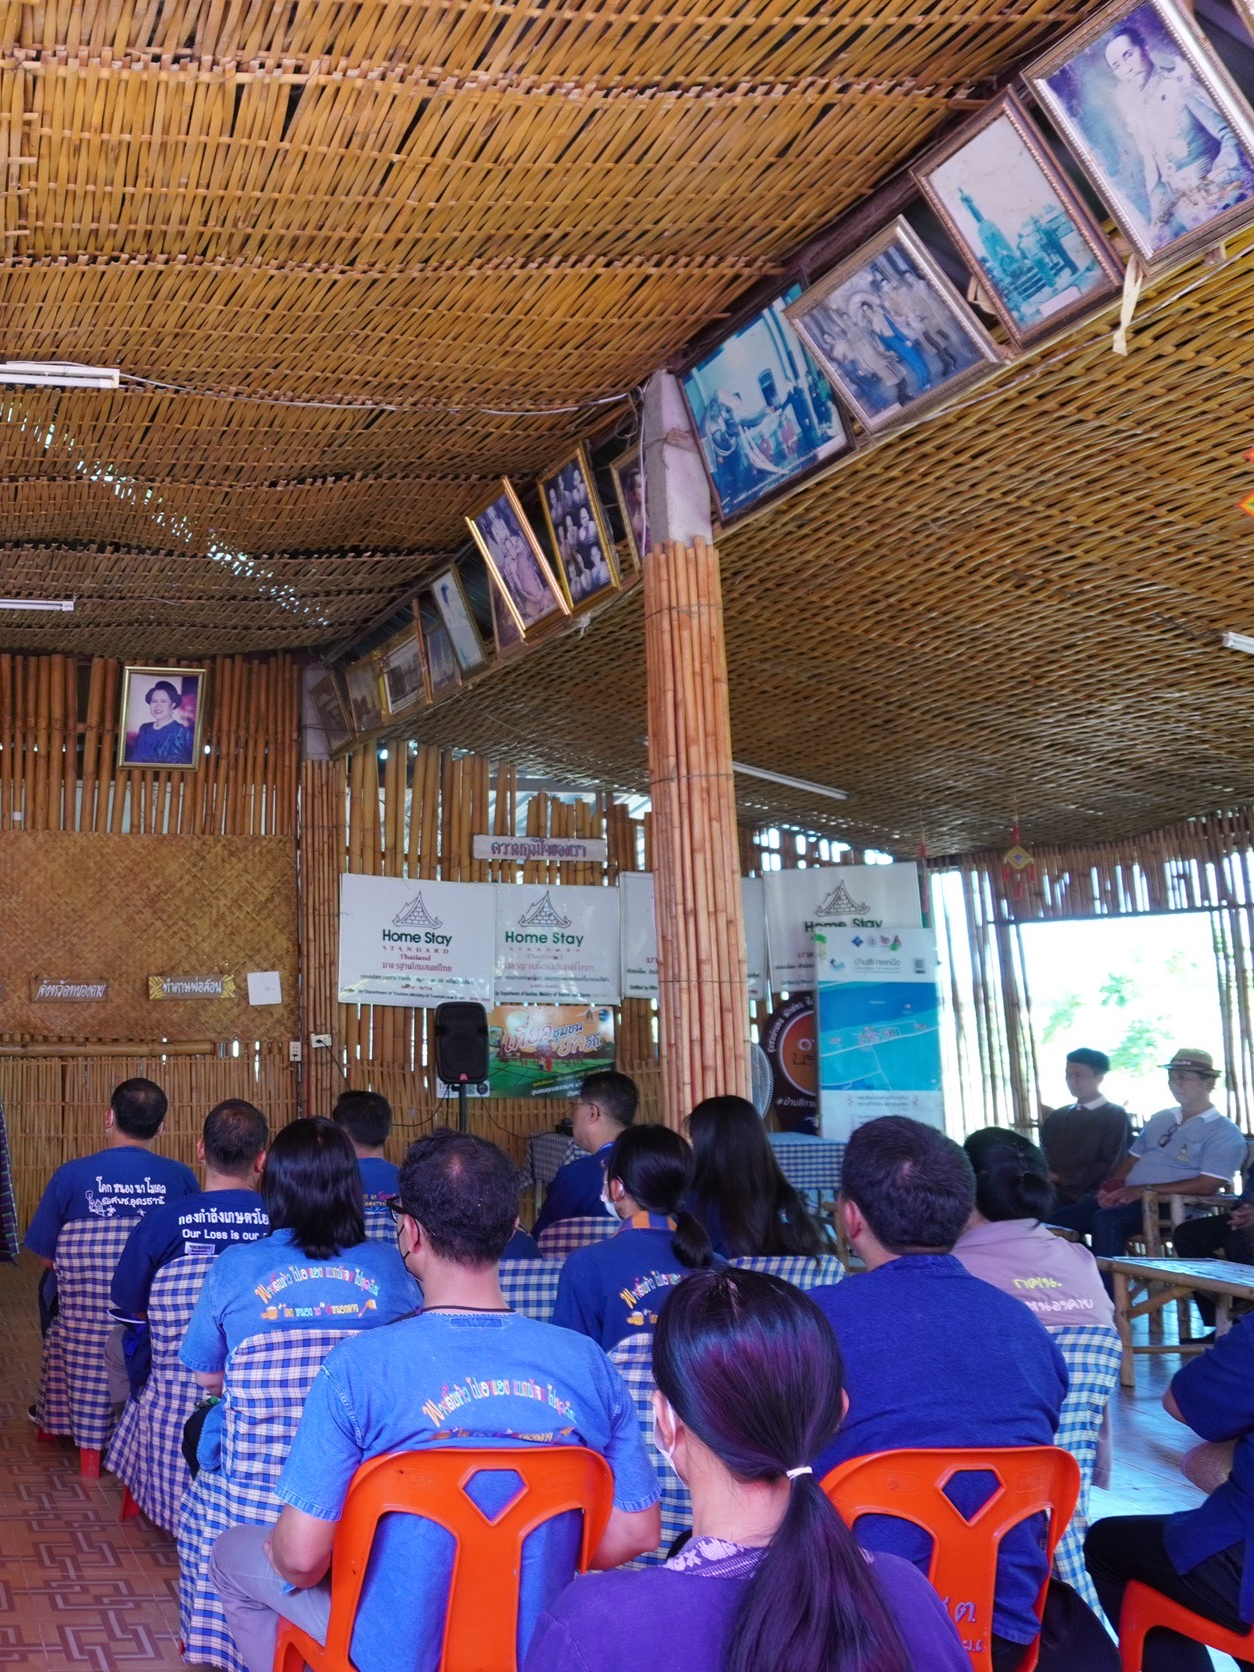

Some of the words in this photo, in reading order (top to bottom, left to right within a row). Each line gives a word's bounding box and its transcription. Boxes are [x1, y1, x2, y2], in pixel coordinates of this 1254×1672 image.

[382, 929, 421, 943] Home
[424, 932, 452, 947] Stay
[505, 931, 548, 944] Home
[552, 932, 584, 947] Stay
[400, 953, 431, 961] Thailand
[95, 1175, 112, 1194] โคก
[113, 1183, 134, 1194] หนอง
[134, 1183, 146, 1194] นา
[144, 1176, 166, 1194] โมเดล
[178, 1207, 271, 1226] กองกำลังเกษตรโย
[182, 1229, 201, 1239] Our
[204, 1229, 228, 1239] Loss
[230, 1230, 240, 1240] is
[242, 1232, 259, 1240] our
